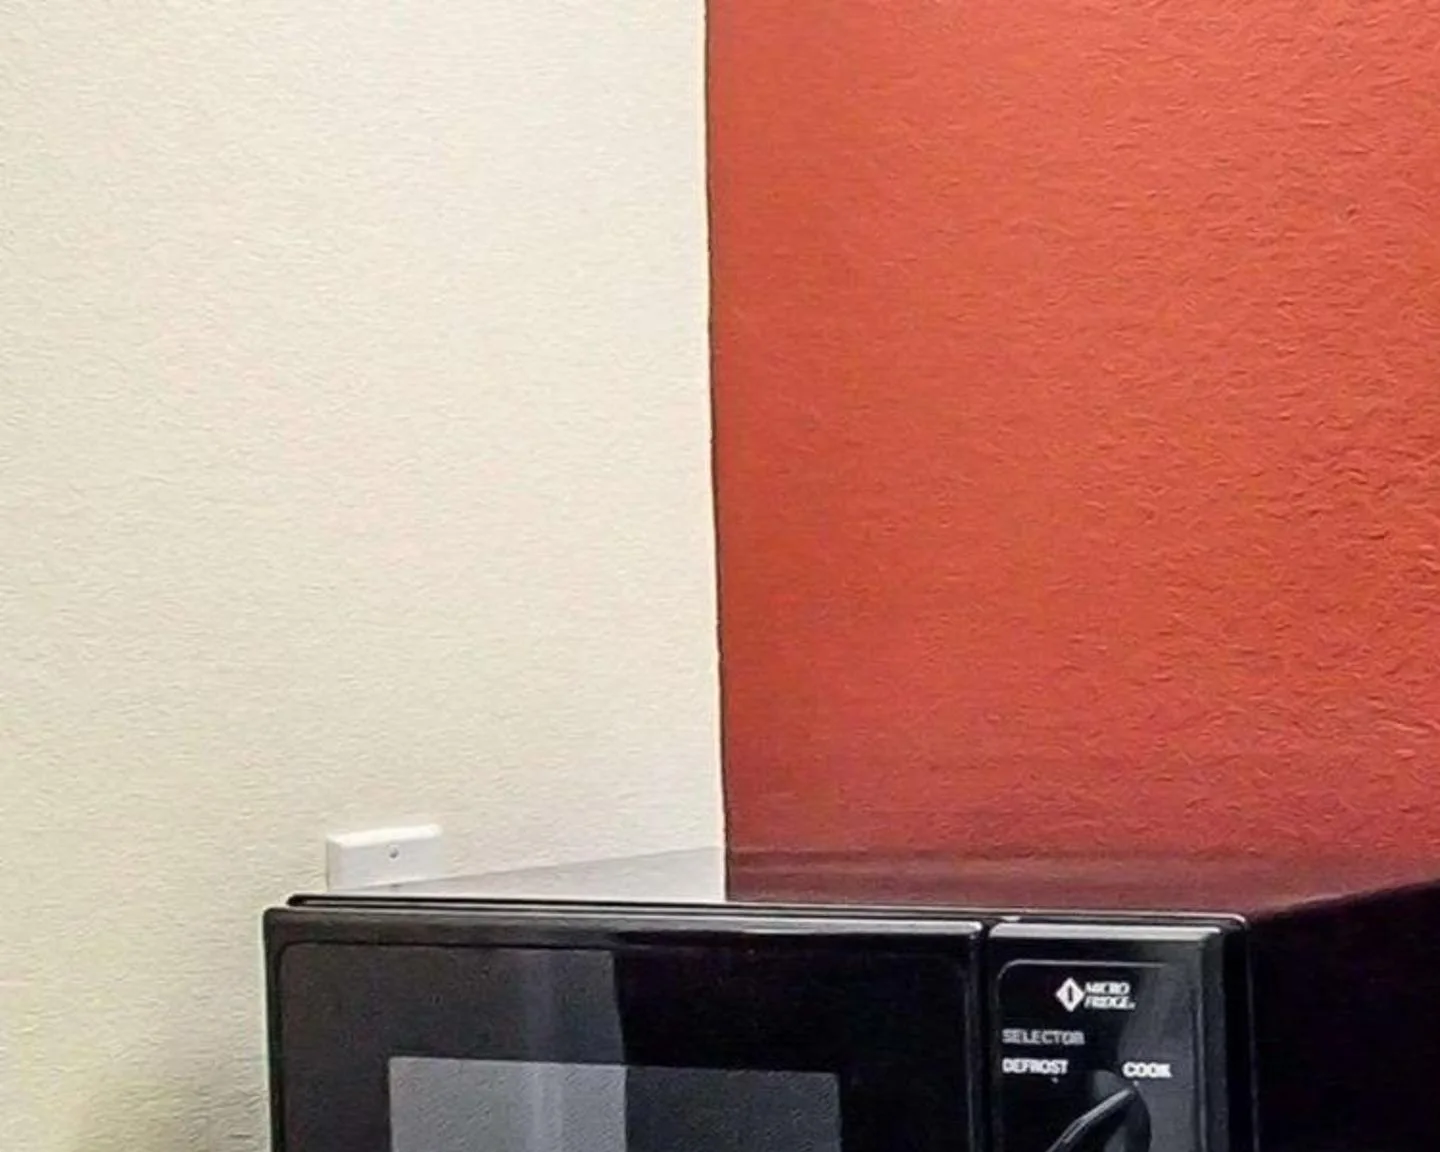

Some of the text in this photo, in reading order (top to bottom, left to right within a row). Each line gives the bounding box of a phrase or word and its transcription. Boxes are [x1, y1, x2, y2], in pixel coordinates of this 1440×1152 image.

[1002, 1029, 1085, 1045] SELECTOR
[1002, 1057, 1069, 1074] DEFROST
[1122, 1061, 1173, 1078] COOK
